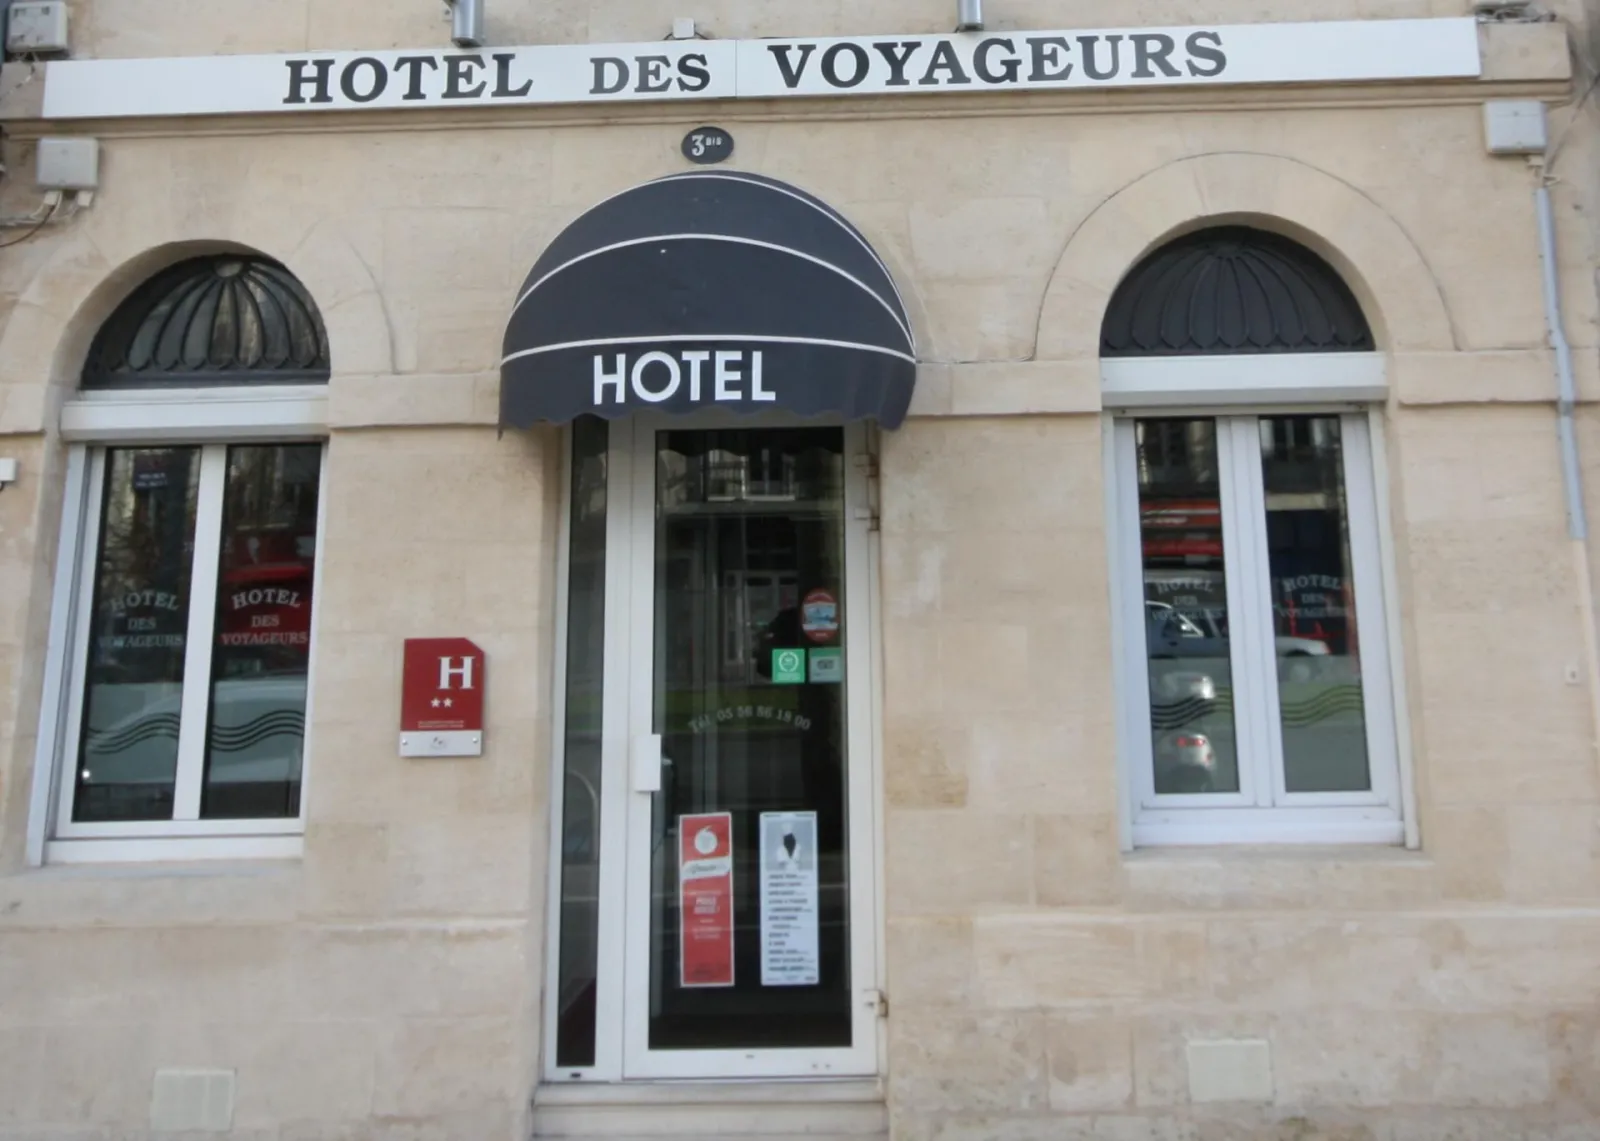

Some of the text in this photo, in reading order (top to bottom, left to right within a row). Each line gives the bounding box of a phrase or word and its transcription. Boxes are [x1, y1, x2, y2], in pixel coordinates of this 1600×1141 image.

[283, 31, 1228, 104] HOTEL DES VOYAGEURS
[593, 350, 776, 405] HOTEL
[1282, 575, 1342, 593] HOTEL
[110, 588, 180, 611] HOTEL
[231, 588, 301, 610] HOTEL
[128, 616, 157, 630] DES
[251, 615, 280, 628] DES
[220, 632, 309, 646] VOYAGEURS
[436, 655, 476, 690] H
[717, 707, 733, 722] 05
[794, 715, 811, 730] 00
